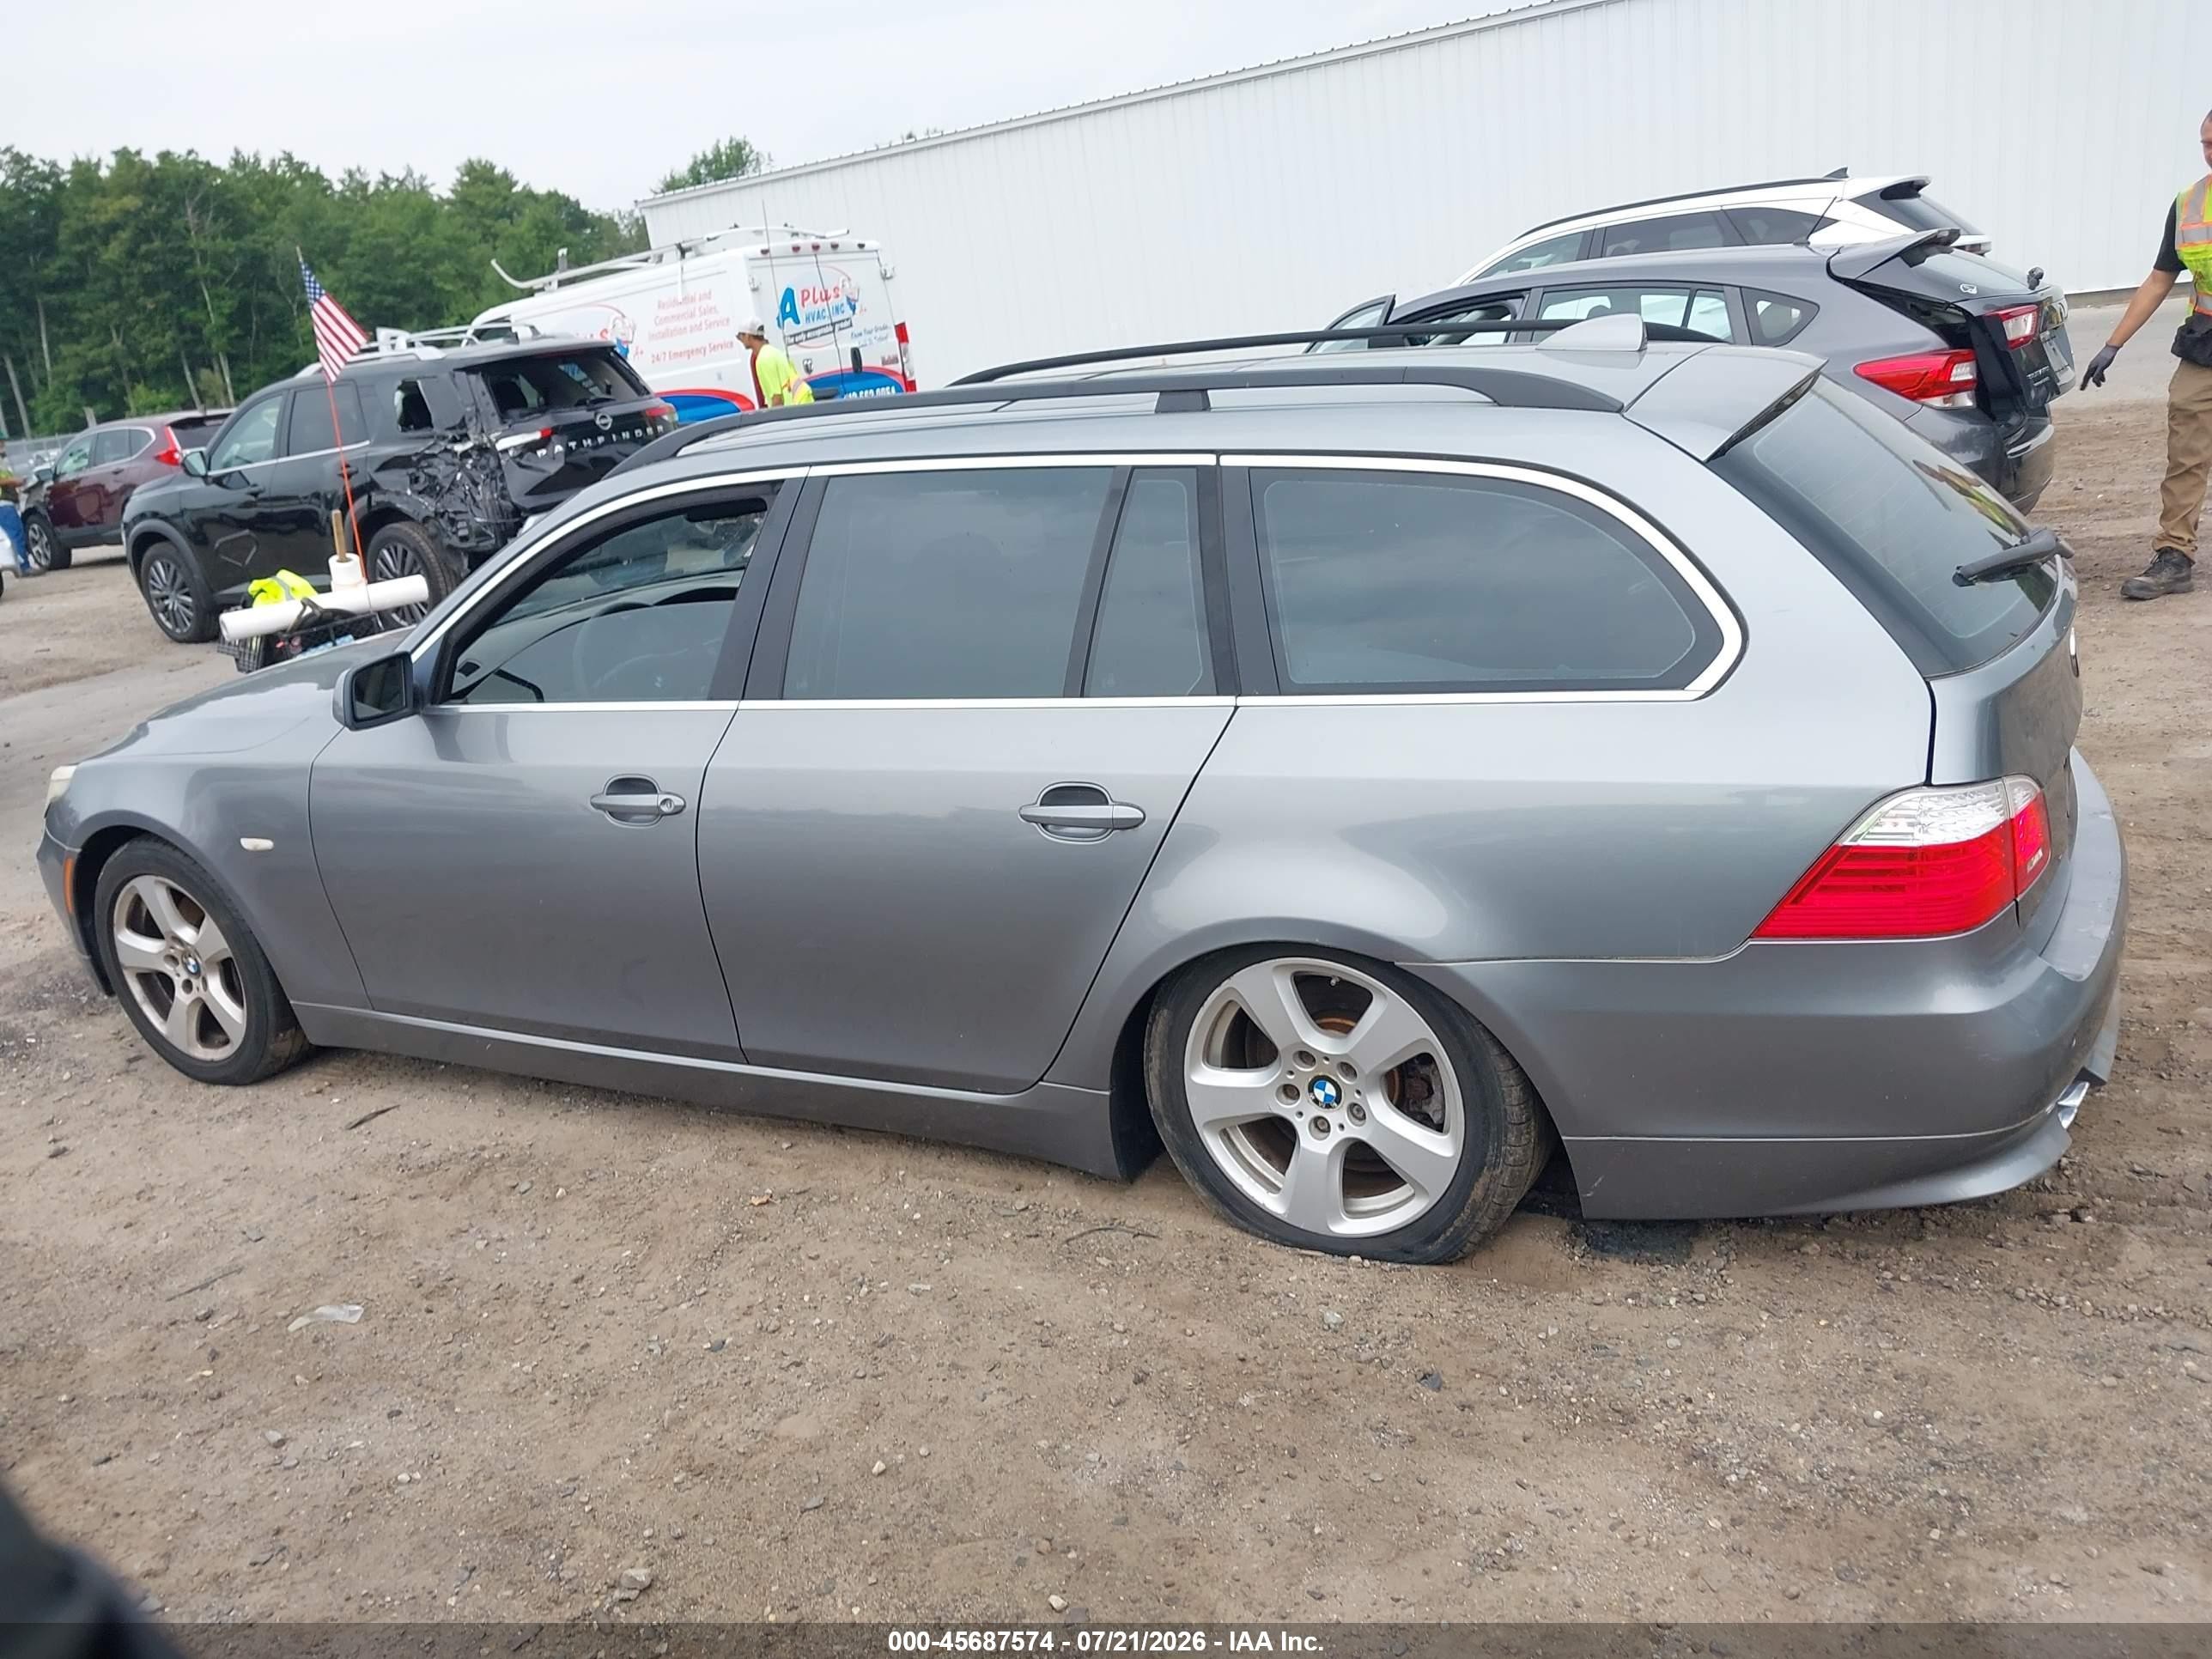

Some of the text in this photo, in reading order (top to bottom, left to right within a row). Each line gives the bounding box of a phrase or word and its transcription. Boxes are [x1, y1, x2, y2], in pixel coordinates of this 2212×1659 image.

[800, 285, 841, 308] Plus
[654, 307, 696, 326] Commercial
[775, 288, 801, 330] A
[648, 317, 730, 342] Installation and Service
[668, 346, 707, 360] Emergency
[708, 341, 733, 353] Service
[536, 425, 665, 459] PATHFINDER
